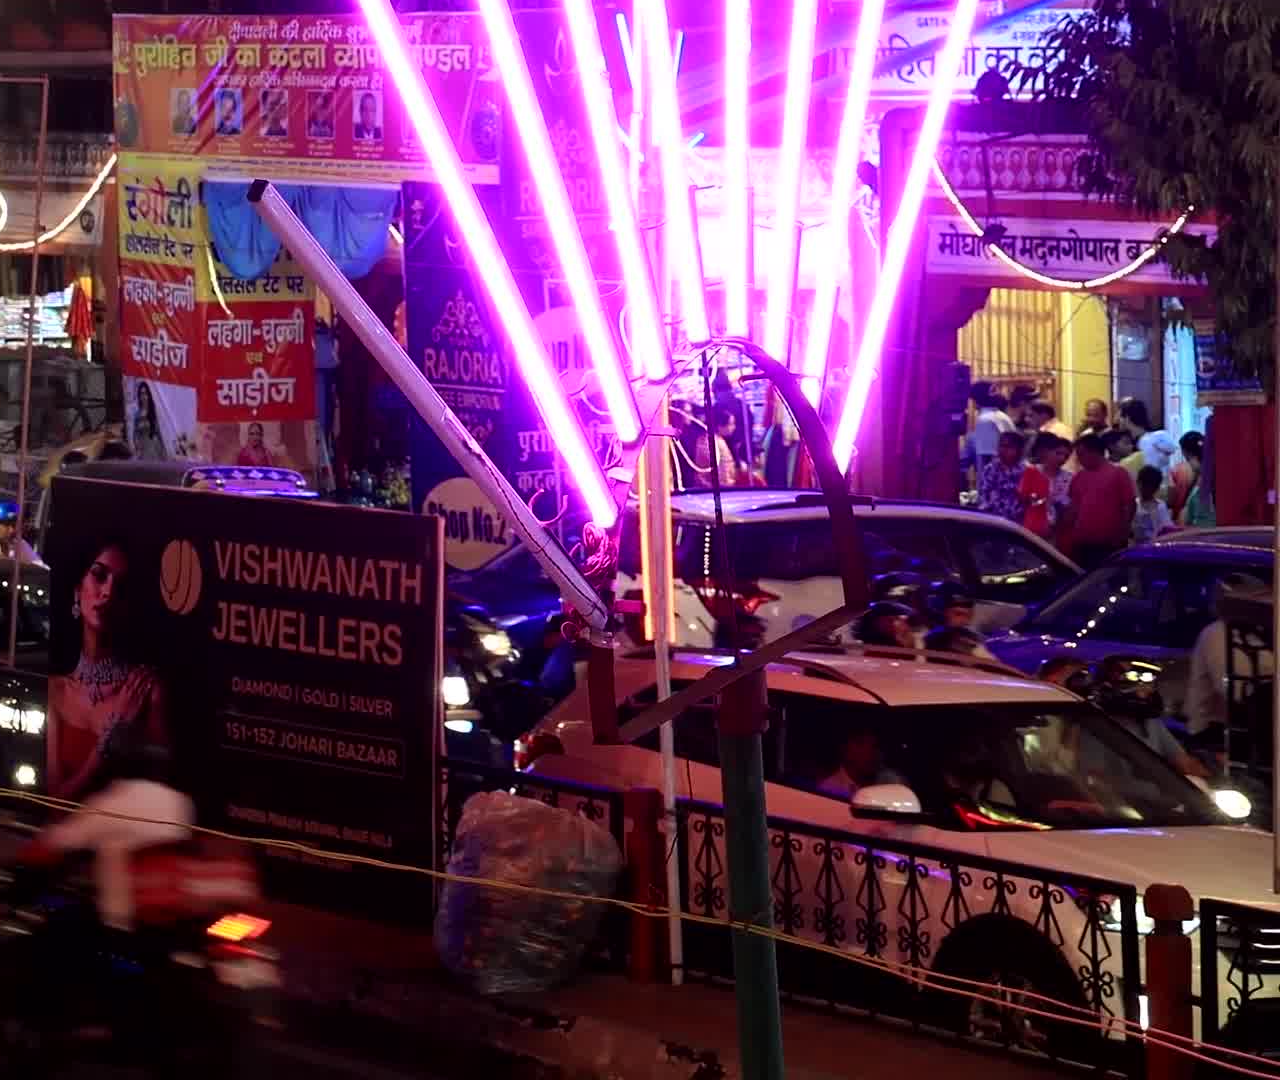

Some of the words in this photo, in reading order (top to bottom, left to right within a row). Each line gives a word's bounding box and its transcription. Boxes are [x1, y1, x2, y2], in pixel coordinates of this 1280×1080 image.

[133, 34, 196, 78] पुरोहित
[201, 35, 229, 68] जी
[236, 43, 260, 67] का
[268, 44, 327, 71] कटला
[406, 44, 473, 73] ण्डल
[124, 176, 191, 228] रंगोली
[1020, 229, 1120, 266] मदनगोपाल
[286, 276, 304, 293] पर
[128, 327, 188, 377] साड़ीज
[216, 367, 297, 417] साड़ीज
[215, 540, 423, 605] VISHWANATH
[212, 602, 403, 666] JEWELLERS
[231, 676, 292, 701] DIAMOND
[302, 687, 339, 708] GOLD
[349, 694, 393, 719] SILVER
[226, 721, 276, 746] 151-152
[278, 731, 333, 758] JOHARI
[336, 740, 399, 767] BAZAAR
